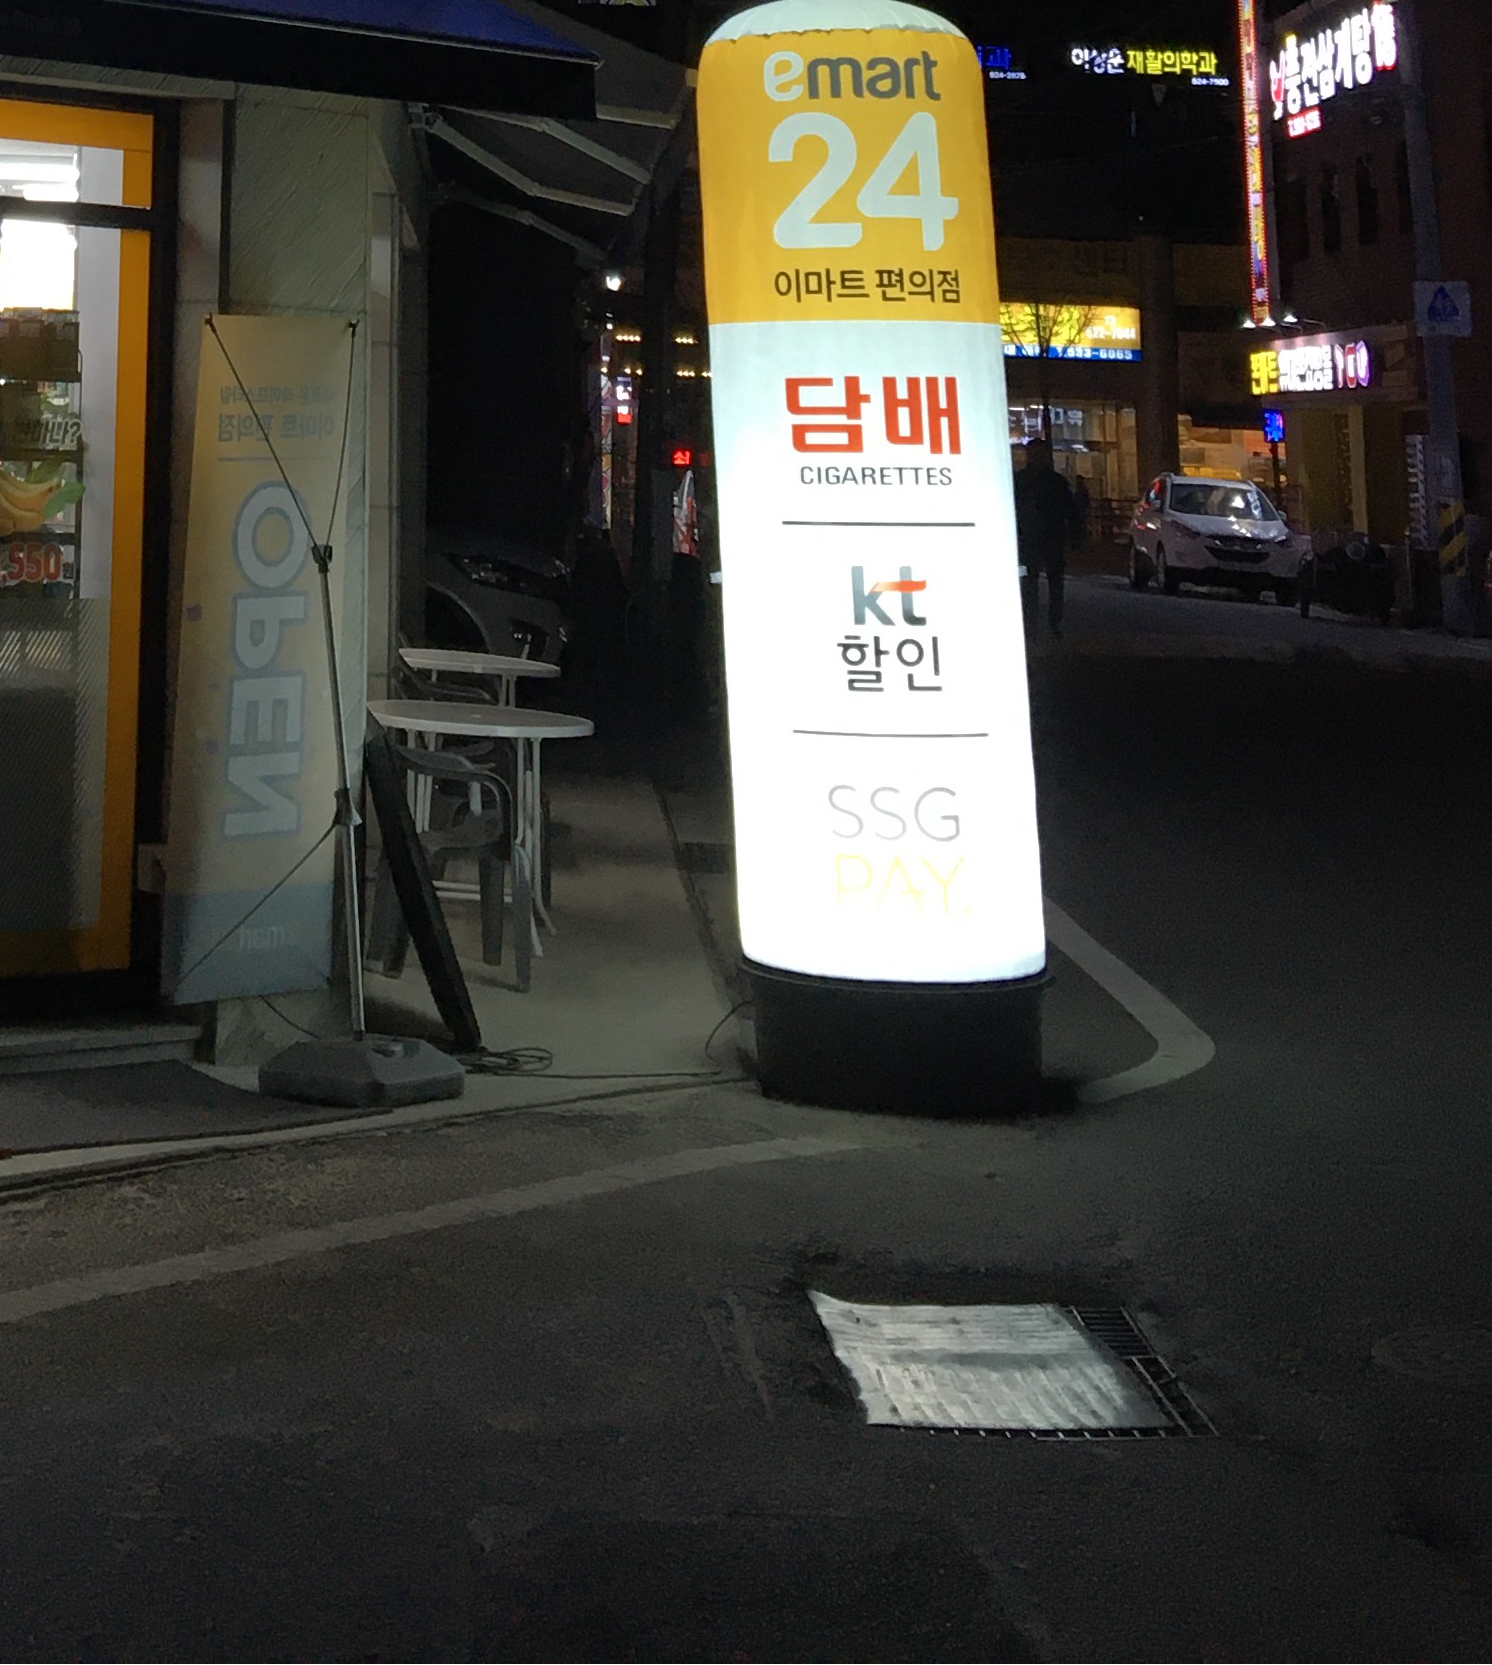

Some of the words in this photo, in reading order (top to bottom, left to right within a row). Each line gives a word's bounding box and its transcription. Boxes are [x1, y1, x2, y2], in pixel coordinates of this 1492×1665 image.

[763, 51, 941, 102] emart
[1126, 49, 1218, 76] 재활의학과
[768, 112, 959, 251] 24
[774, 269, 871, 303] 이마트
[876, 268, 961, 303] 편의점
[785, 375, 961, 455] 담배
[800, 466, 953, 486] CIGARETTES
[851, 565, 927, 626] kt
[837, 635, 942, 693] 할인
[828, 784, 960, 842] SSG
